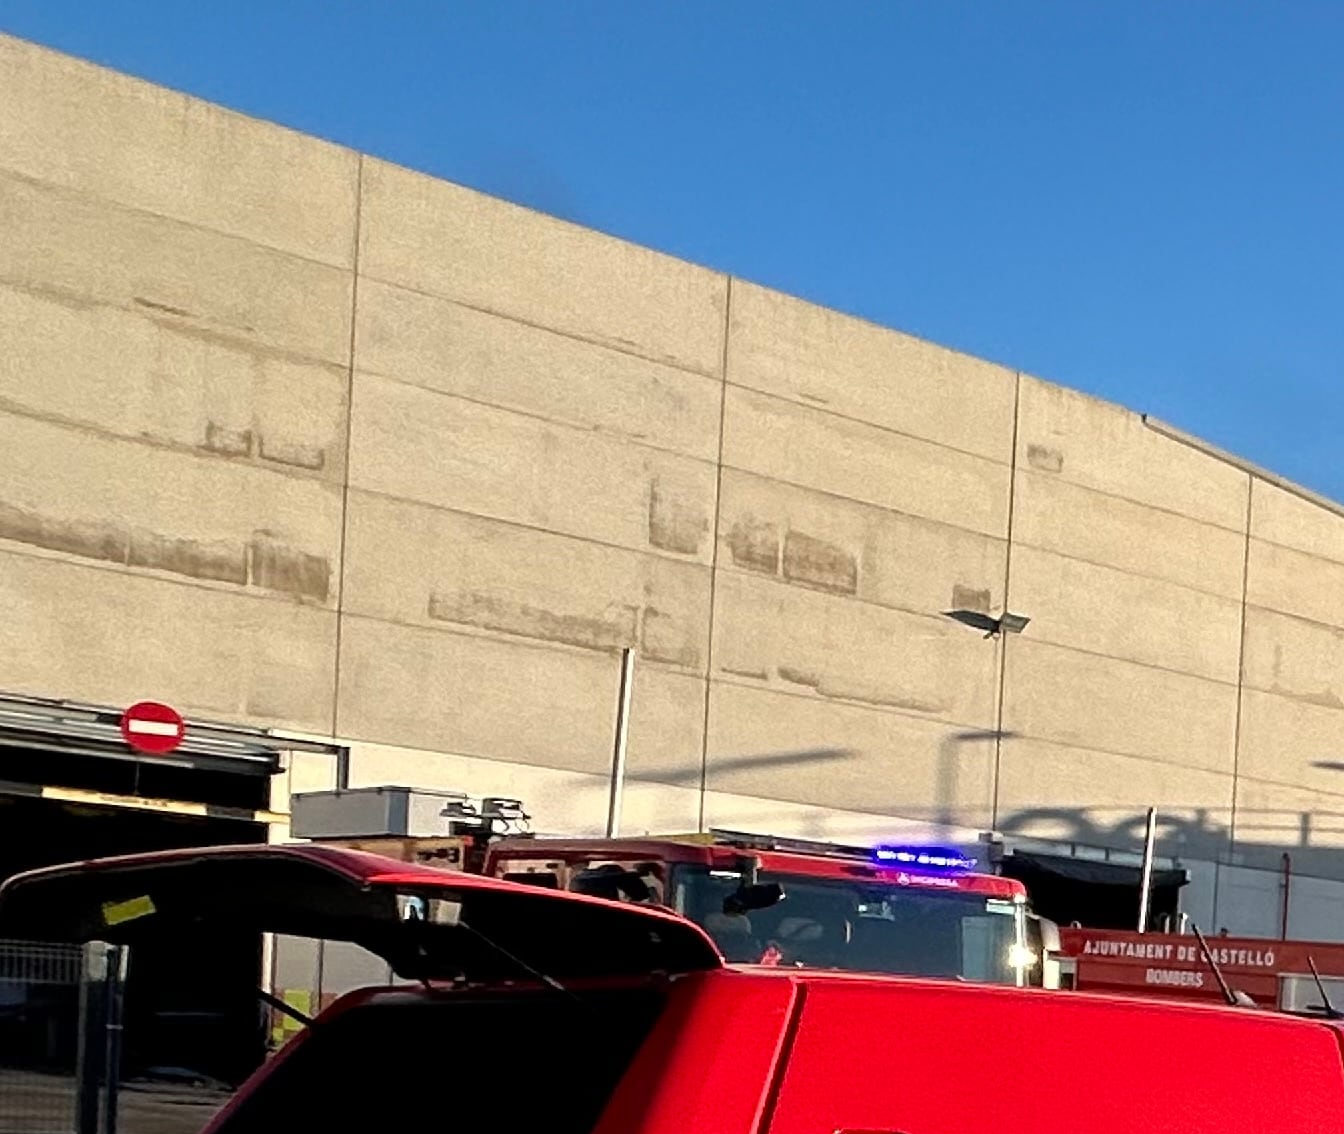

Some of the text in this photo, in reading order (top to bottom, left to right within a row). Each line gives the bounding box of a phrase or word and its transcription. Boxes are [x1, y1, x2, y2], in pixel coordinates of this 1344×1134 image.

[1083, 939, 1172, 960] AJUNTAMENT
[1176, 945, 1196, 962] DE
[1145, 967, 1204, 988] BOMBERS
